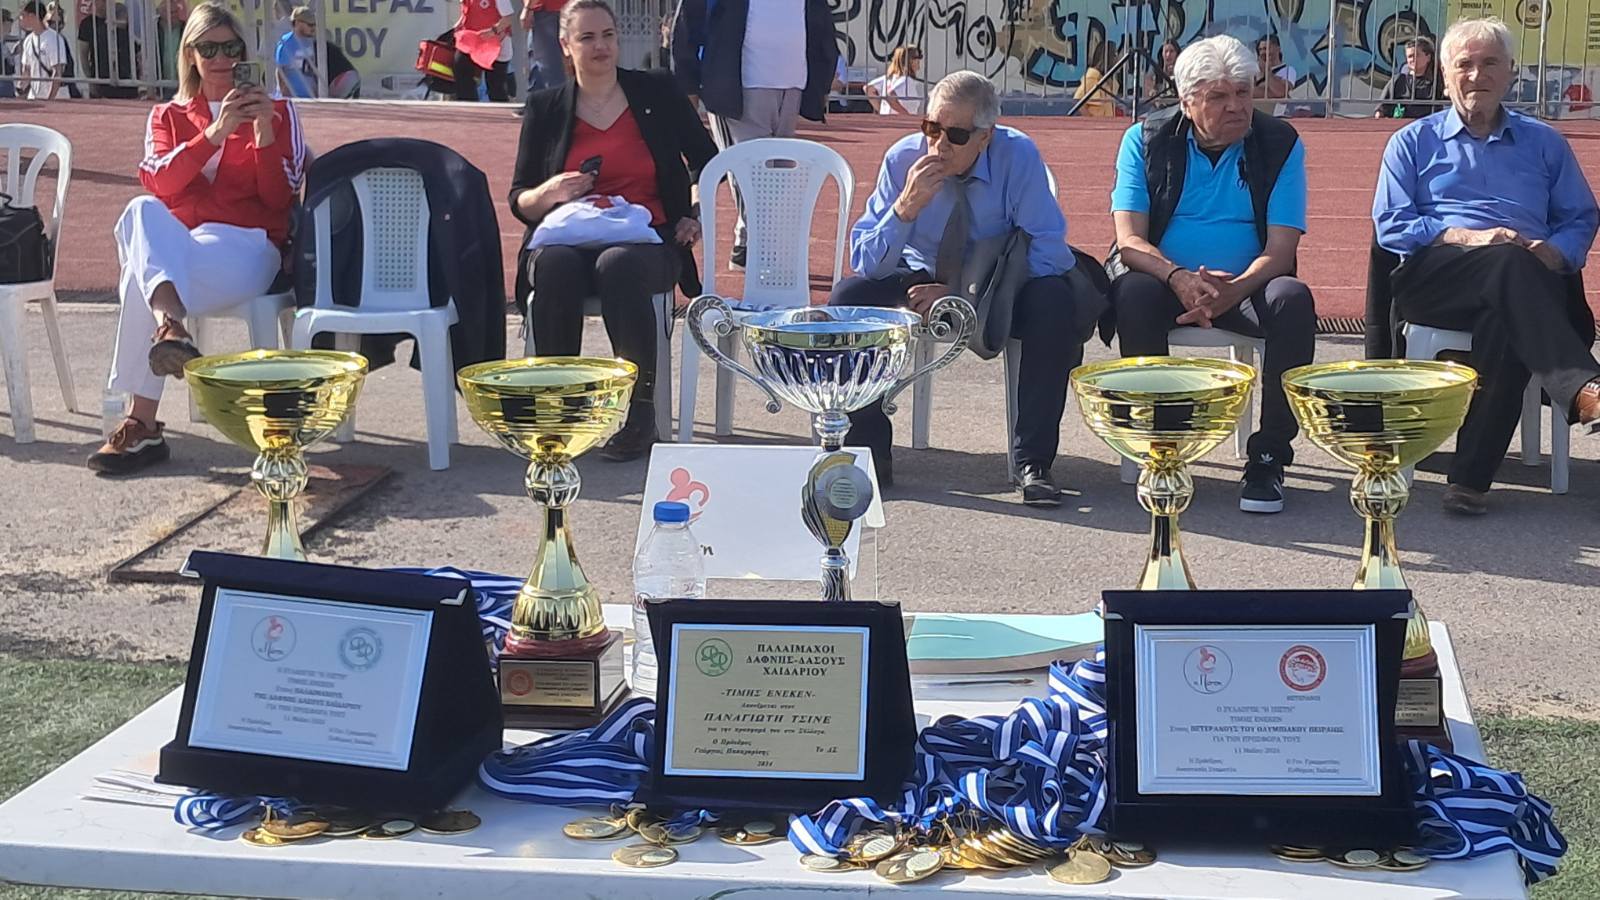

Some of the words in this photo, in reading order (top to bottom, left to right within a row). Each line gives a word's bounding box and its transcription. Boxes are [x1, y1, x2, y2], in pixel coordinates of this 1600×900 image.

[745, 655, 846, 666] ΔΑΦΝΗΣ-ΔΑΣΟΥΣ
[703, 712, 785, 723] ΠΑΝΑΓΙΩΤΗ
[791, 714, 832, 724] ΤΣΙΝΕ
